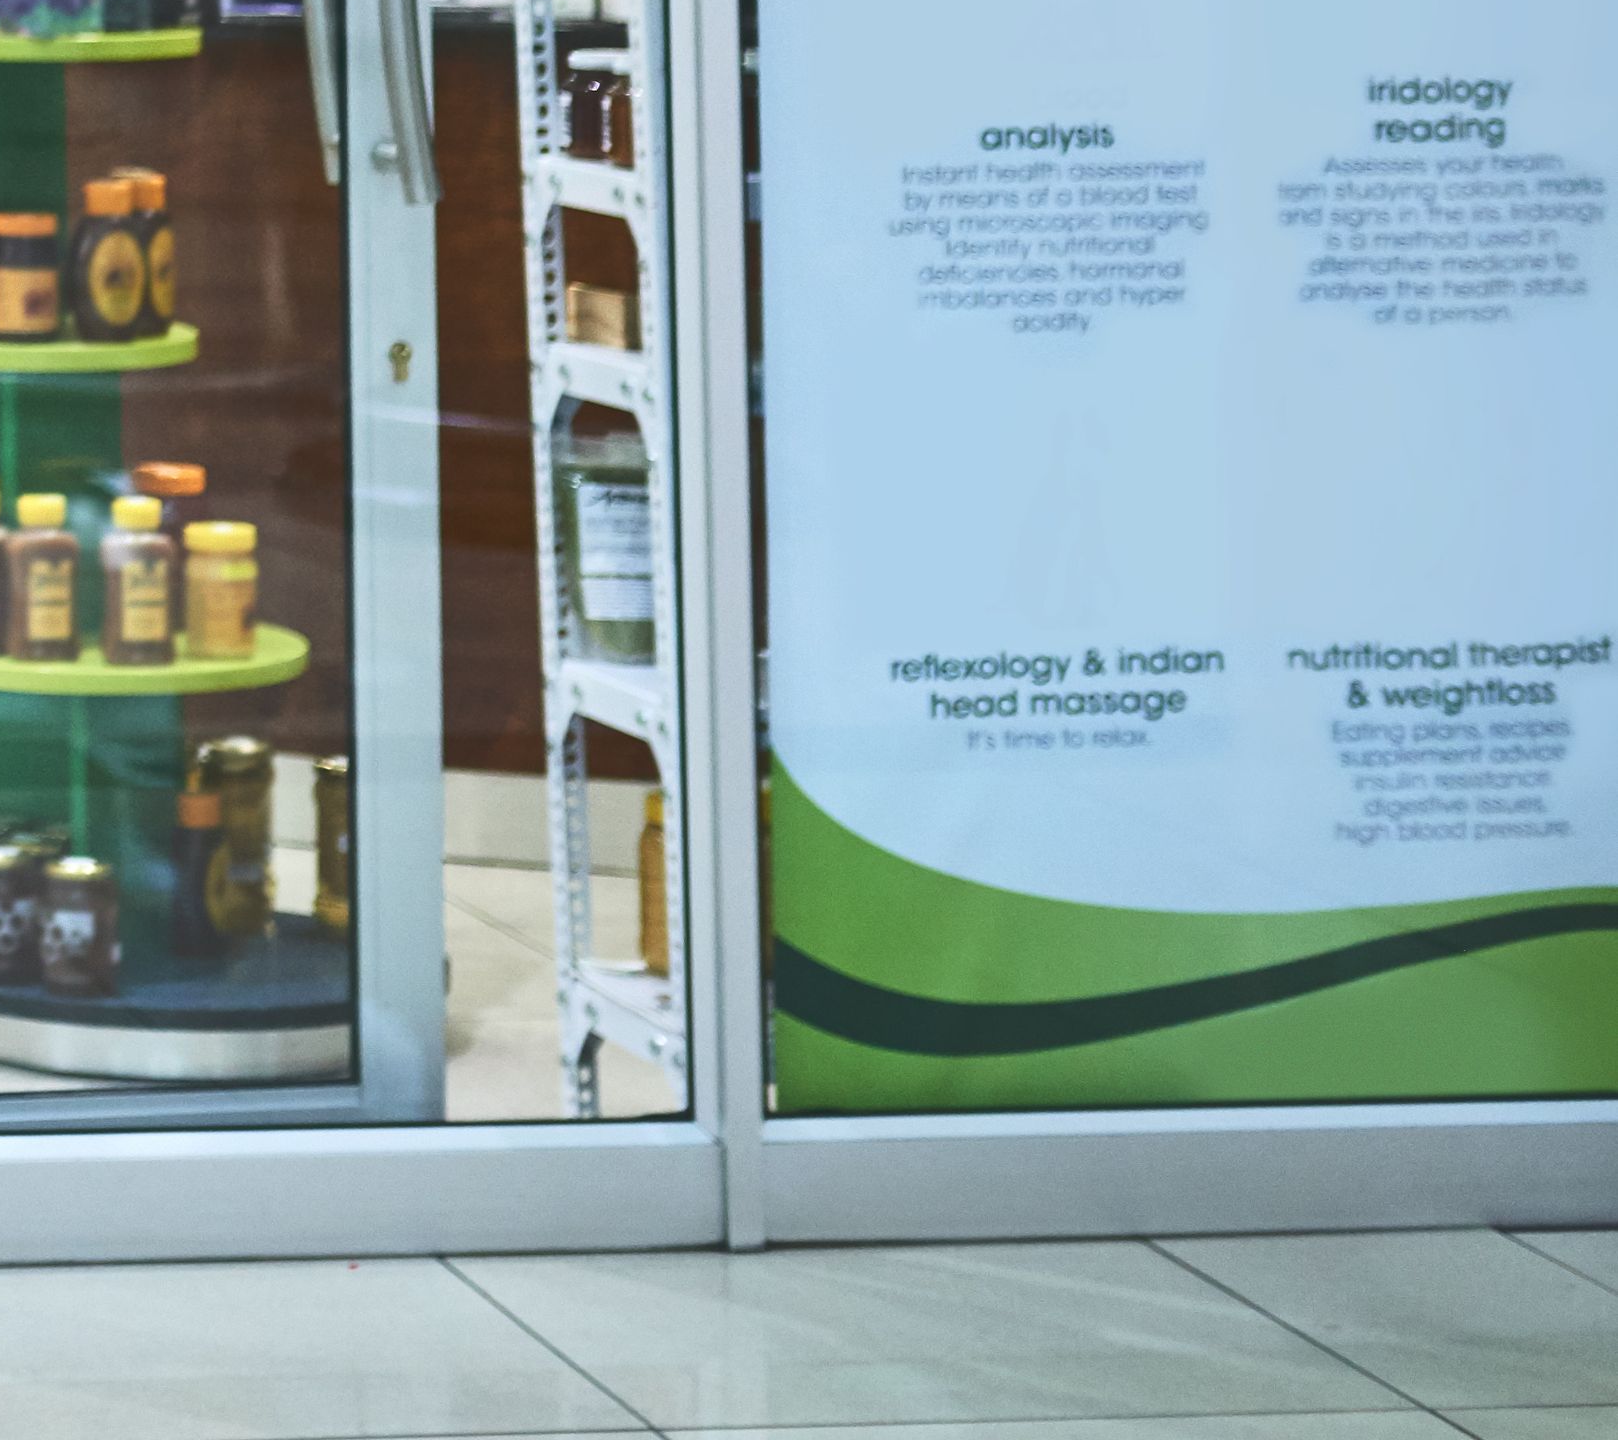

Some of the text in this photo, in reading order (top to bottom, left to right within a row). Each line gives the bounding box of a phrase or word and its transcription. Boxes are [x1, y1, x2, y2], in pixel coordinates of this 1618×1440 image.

[1368, 77, 1513, 110] iridology
[980, 121, 1115, 156] analysis
[1373, 114, 1506, 149] reading
[891, 646, 1225, 685] reflexology & indian
[1287, 636, 1612, 671] nutritional therapist
[929, 688, 1188, 722] head massage
[1347, 678, 1557, 716] & weightloss
